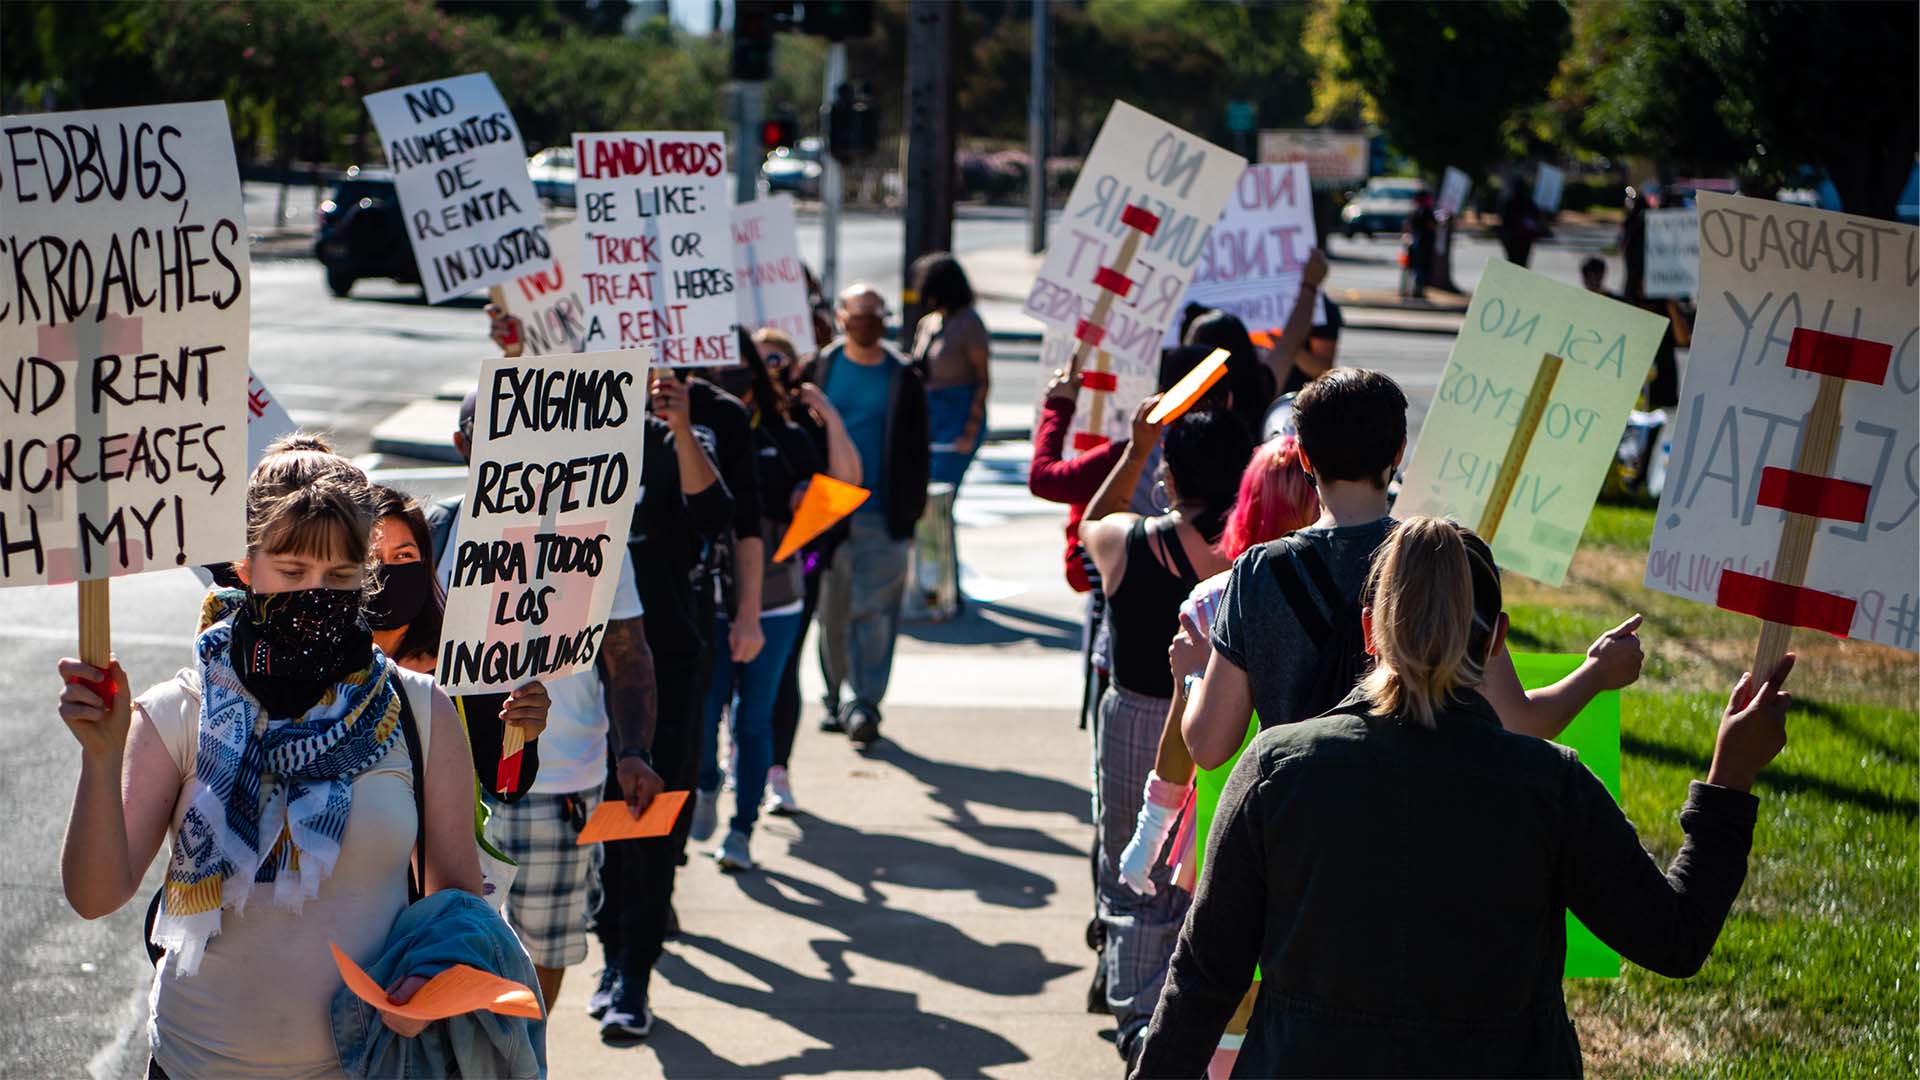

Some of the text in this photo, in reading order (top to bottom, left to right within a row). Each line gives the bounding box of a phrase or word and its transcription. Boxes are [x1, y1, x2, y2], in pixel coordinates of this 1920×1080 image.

[404, 87, 455, 124] NO
[0, 122, 188, 224] EDBUGS,
[390, 112, 512, 174] AUMENTOS
[577, 138, 723, 179] LANDLORDS
[435, 158, 483, 199] DE
[585, 184, 706, 222] BE LIKE:
[413, 188, 522, 240] RENTA
[0, 218, 242, 327] KROACHES
[433, 225, 551, 293] INJUSTAS
[585, 232, 704, 265] "TRICK OR
[582, 272, 657, 305] TREAT
[526, 292, 586, 355] WOR
[587, 304, 688, 343] A RENT
[0, 357, 65, 416] ND
[92, 345, 225, 414] RENT
[489, 367, 633, 440] EXIGIMOS
[0, 423, 225, 495] CREASES,
[472, 452, 629, 519] RESPETO
[0, 495, 187, 577] H MY!
[453, 533, 611, 588] PARA TODOS
[495, 585, 556, 625] LOS
[440, 623, 603, 687] INQUILINOS
